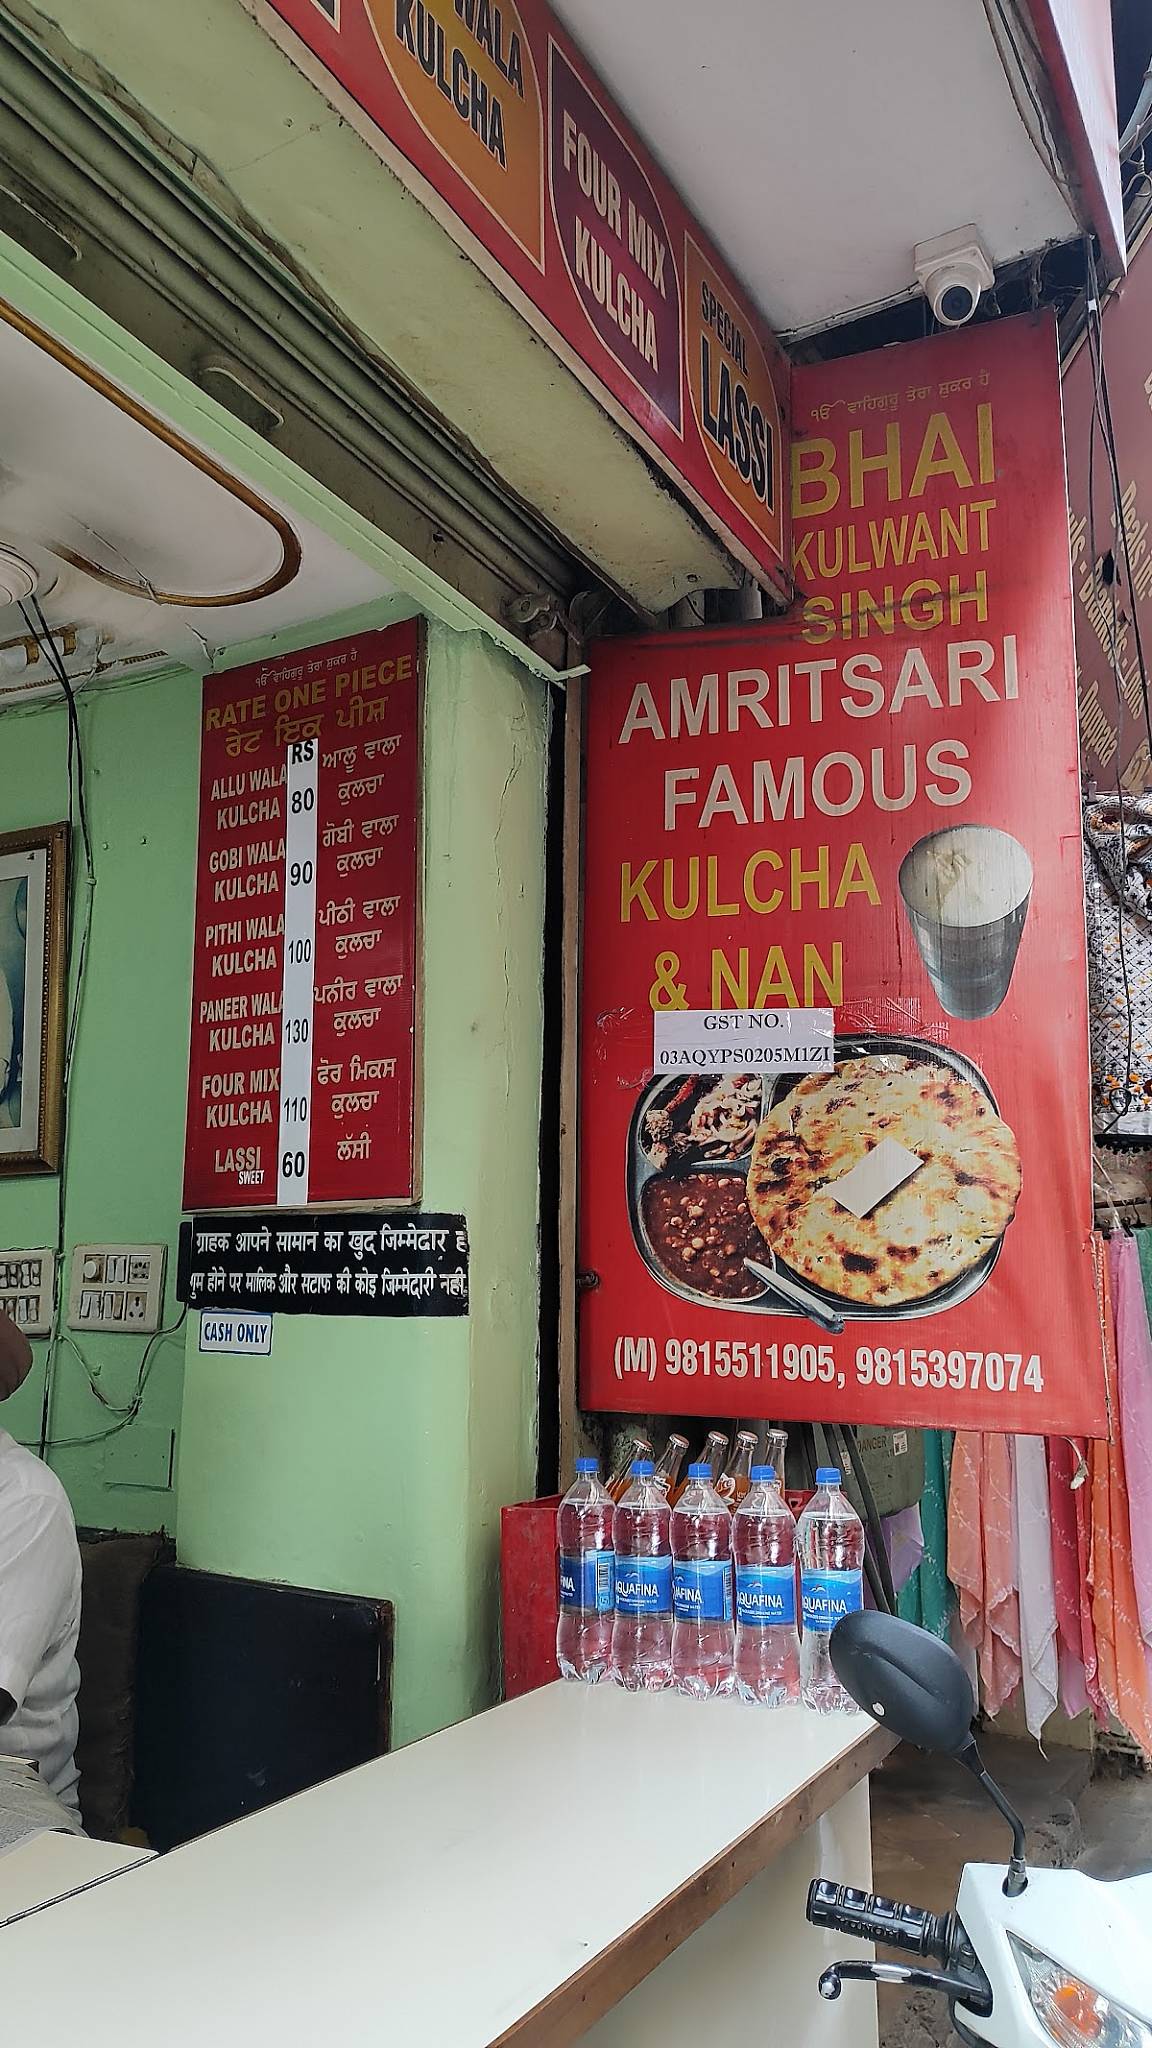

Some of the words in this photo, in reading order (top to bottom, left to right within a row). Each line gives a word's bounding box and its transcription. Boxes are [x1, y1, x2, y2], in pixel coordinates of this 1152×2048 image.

[395, 0, 507, 172] KULCHA
[563, 109, 622, 241] FOUR
[628, 197, 667, 300] MIX
[575, 215, 659, 375] KULCHA
[701, 280, 749, 379] SPECIAL
[701, 331, 775, 516] LASSI
[791, 402, 996, 519] BHAI
[792, 499, 997, 581] KULWANT
[801, 570, 988, 645] SINGH
[205, 695, 266, 732] RATE
[274, 679, 327, 713] ONE
[335, 655, 412, 698] PIECE
[618, 635, 1019, 744] AMRITSARI
[226, 728, 264, 758] ਰੇਟ
[274, 714, 325, 746] ਇਕ
[291, 740, 314, 765] RS
[322, 746, 358, 773] ਆਲੂ
[364, 735, 402, 759] ਵਾਲਾ
[210, 773, 245, 801] ALLU
[249, 764, 288, 792] WALA
[338, 774, 385, 806] ਕੁਲਚਾ
[664, 739, 973, 831] FAMOUS
[217, 797, 281, 831] KULCHA
[291, 787, 314, 814] 80
[322, 819, 354, 847] ਗੋਬੀ
[362, 815, 399, 839] ਵਾਲਾ
[209, 846, 243, 874] GOBI
[247, 838, 286, 866] WALA
[336, 847, 384, 878] ਕੁਲਚਾ
[214, 870, 279, 903] KULCHA
[290, 860, 313, 886] 90
[620, 842, 881, 923] KULCHA
[318, 897, 355, 926] ਪੀਠੀ
[362, 895, 401, 920] ਵਾਲਾ
[205, 921, 242, 948] PITHI
[246, 914, 285, 941] WALA
[335, 929, 382, 960] ਕੁਲਚਾ
[212, 946, 277, 978] KULCHA
[288, 938, 312, 964] 100
[314, 976, 358, 1004] ਪਨੀਰ
[364, 974, 403, 999] ਵਾਲਾ
[649, 951, 690, 1010] &
[711, 941, 844, 1009] NAN
[200, 995, 248, 1024] PANEER
[333, 1007, 382, 1037] ਕੁਲਚਾ
[703, 1014, 744, 1031] GST
[748, 1013, 784, 1029] NO.
[209, 1022, 275, 1052] KULCHA
[285, 1018, 309, 1044] 130
[201, 1072, 245, 1099] FOUR
[249, 1067, 280, 1094] MIX
[317, 1057, 343, 1085] ਫੋਰ
[350, 1055, 397, 1082] ਮਿਕਸ
[206, 1099, 273, 1129] KULCHA
[283, 1096, 307, 1122] 110
[331, 1090, 380, 1119] ਕੁਲਚਾ
[215, 1146, 261, 1173] LASSI
[337, 1131, 372, 1161] ਲੱਸੀ
[238, 1169, 265, 1185] SWEET
[282, 1151, 305, 1178] 60
[196, 1232, 232, 1254] ग्राहक
[235, 1225, 272, 1252] आपने
[276, 1231, 319, 1252] सामान
[323, 1231, 344, 1252] का
[348, 1230, 378, 1261] खुद
[189, 1272, 205, 1300] गुम
[207, 1265, 227, 1293] होने
[229, 1272, 244, 1294] पर
[245, 1265, 278, 1294] मालिक
[278, 1263, 299, 1295] और
[336, 1266, 353, 1295] की
[381, 1266, 438, 1300] जिम्मेदारी
[204, 1321, 233, 1343] CASH
[237, 1323, 268, 1345] ONLY
[613, 1336, 657, 1381] (M)
[665, 1338, 846, 1390] 9815511905,
[856, 1347, 1044, 1393] 9815397074
[803, 1595, 847, 1614] QUAFINA
